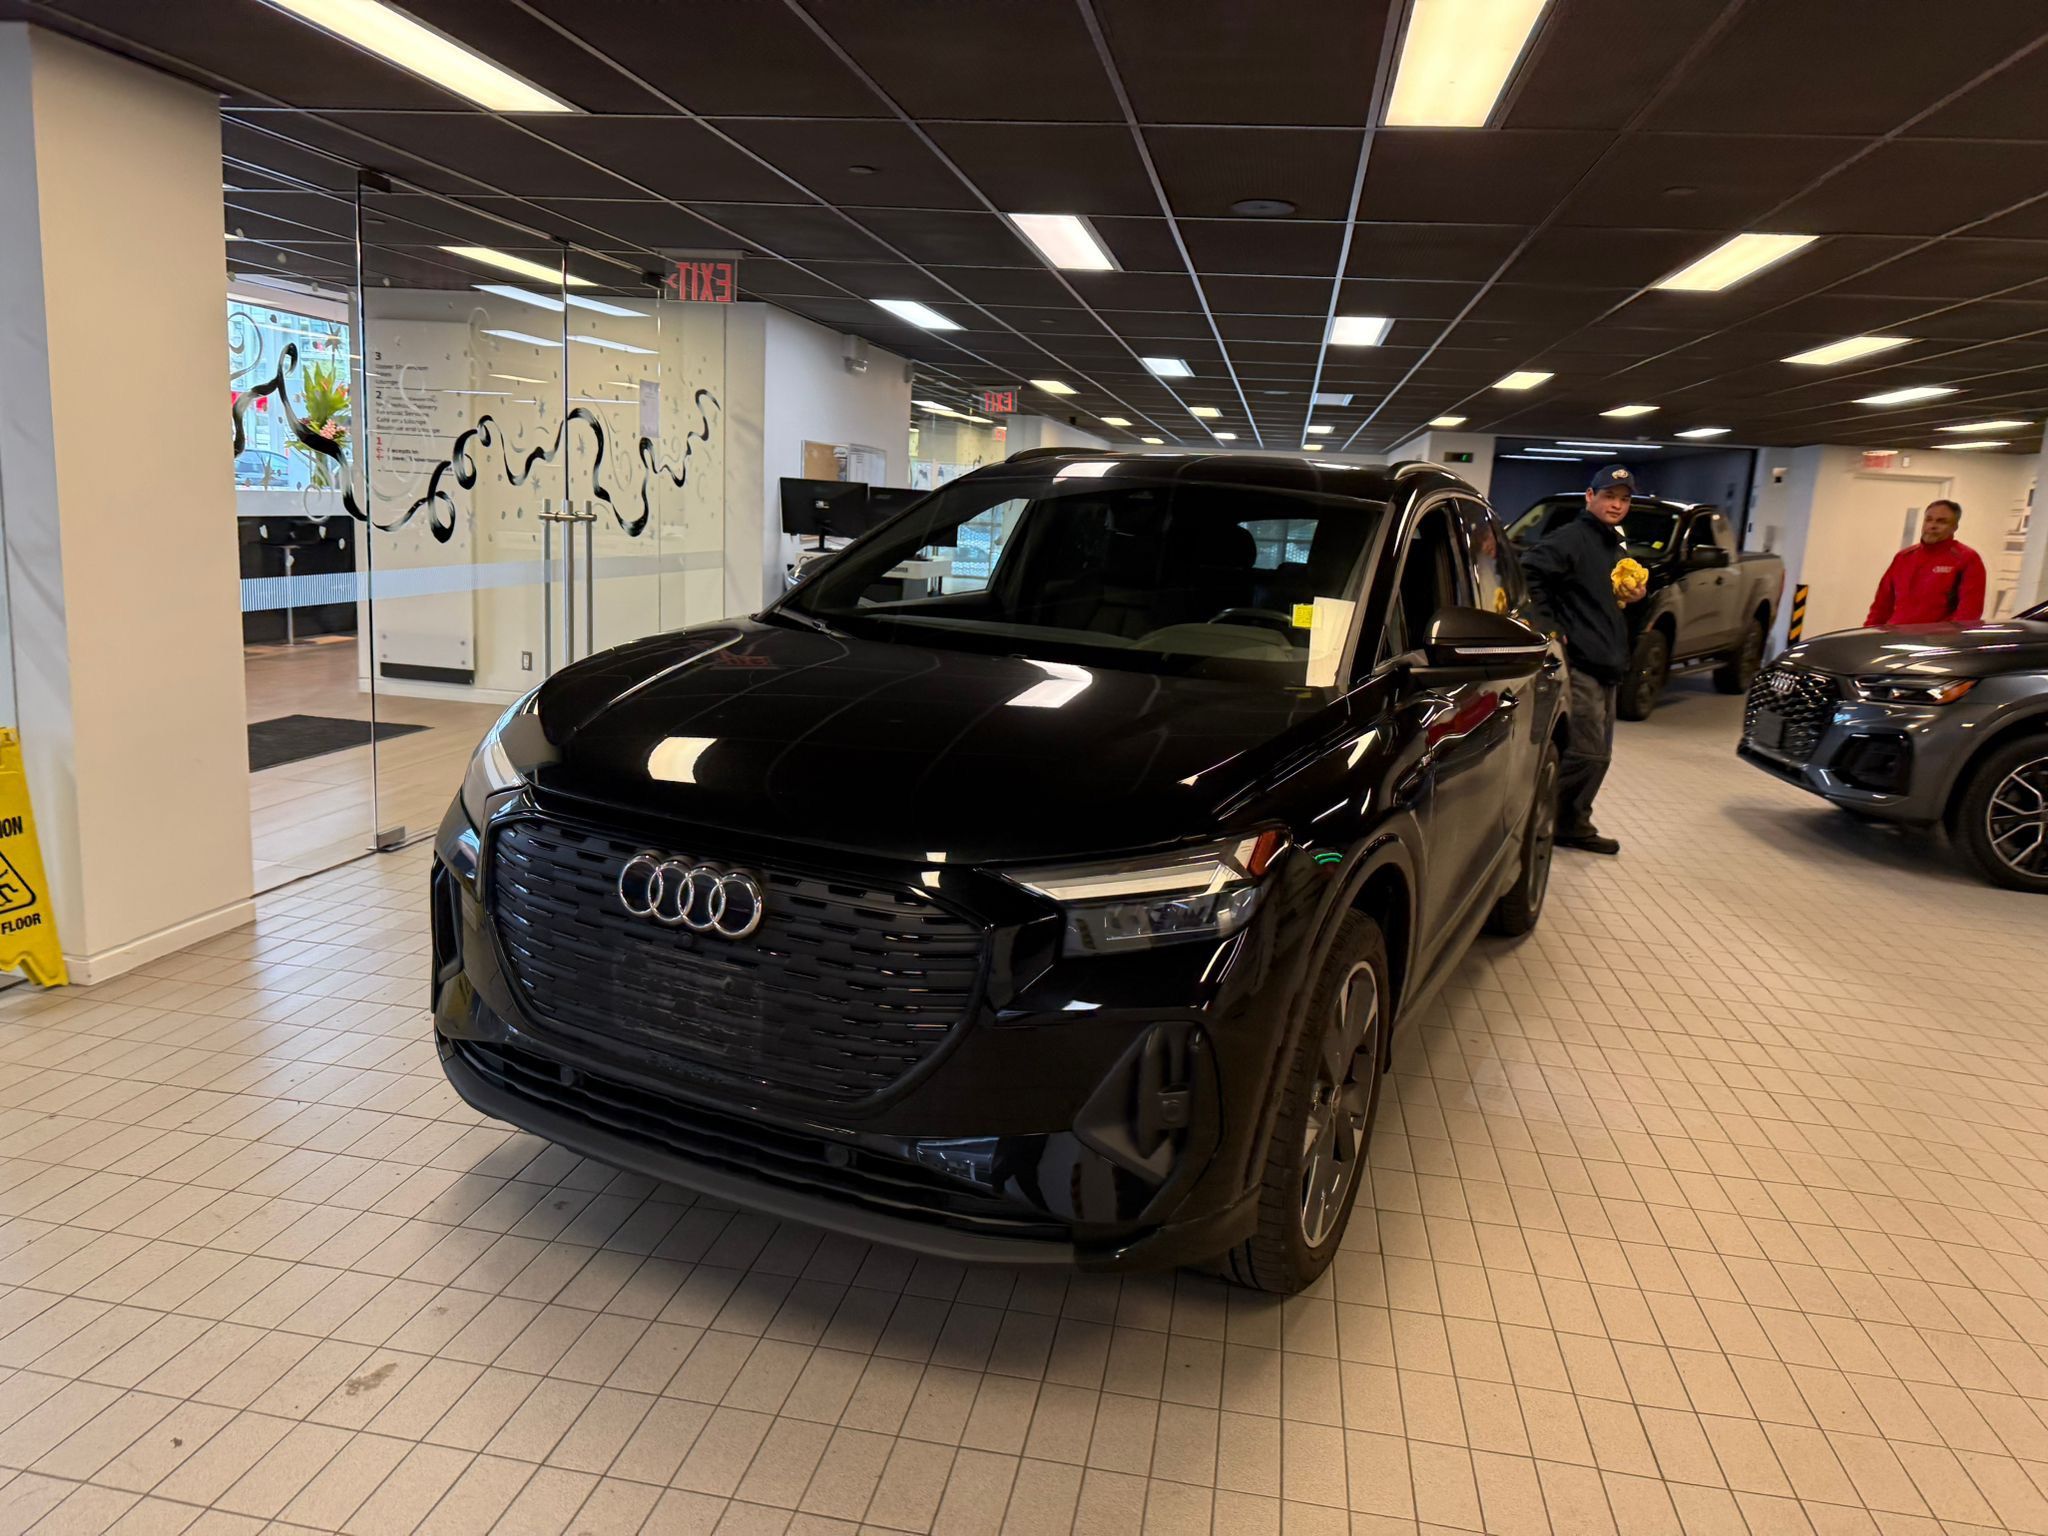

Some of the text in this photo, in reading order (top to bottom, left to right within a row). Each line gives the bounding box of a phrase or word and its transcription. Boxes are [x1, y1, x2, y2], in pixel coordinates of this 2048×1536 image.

[375, 351, 382, 361] 3
[375, 390, 382, 399] 2
[376, 436, 382, 445] 1
[1, 913, 42, 935] FLOOR
